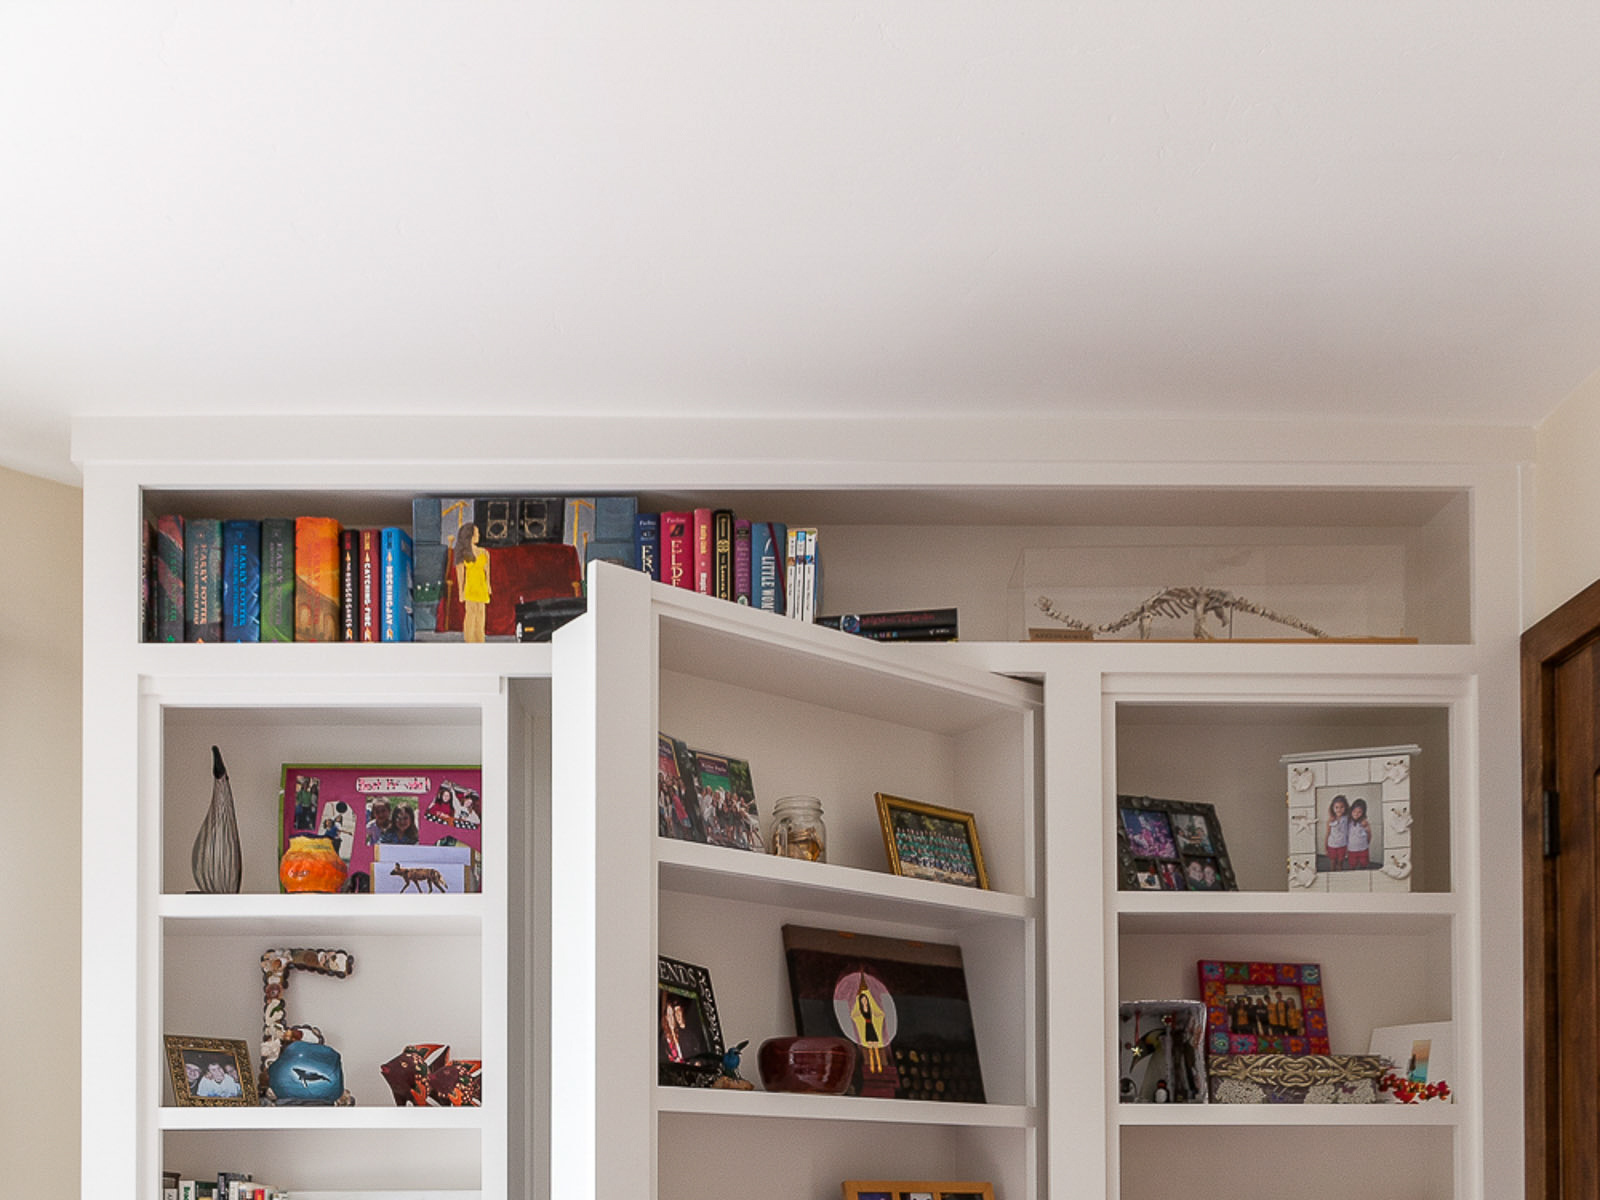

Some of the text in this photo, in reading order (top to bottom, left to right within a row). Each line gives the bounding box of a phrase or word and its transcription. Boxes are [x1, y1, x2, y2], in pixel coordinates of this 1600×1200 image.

[200, 544, 208, 625] HARRY POTTER
[239, 545, 248, 626] HARRY POTTER
[363, 562, 372, 627] CATCHING FIRE
[385, 565, 394, 625] MOCKINGJAY
[761, 556, 775, 613] LITTLE WOM
